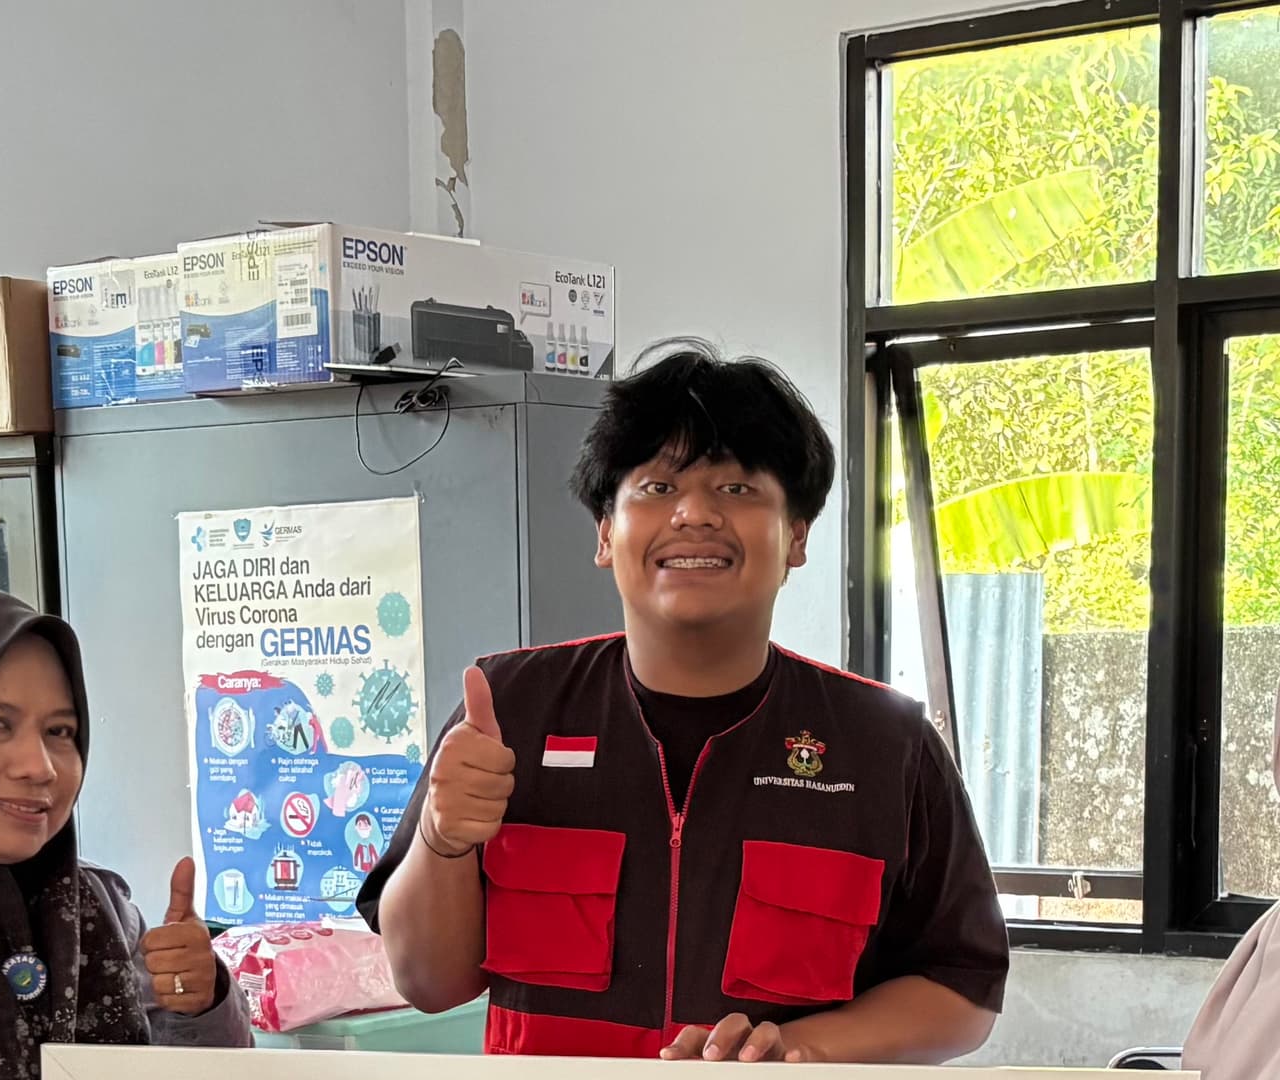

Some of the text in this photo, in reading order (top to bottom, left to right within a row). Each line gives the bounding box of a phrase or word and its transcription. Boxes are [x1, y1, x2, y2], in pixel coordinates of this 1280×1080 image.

[342, 236, 404, 266] EPSON
[167, 266, 179, 276] L12
[183, 252, 224, 272] EPSON
[343, 261, 404, 275] EXCEED YOUR VISION
[53, 277, 93, 295] EPSON
[555, 271, 606, 289] EcoTank L121
[275, 526, 302, 535] GERMAS
[193, 556, 310, 580] JAGA DIRI dan
[195, 576, 371, 603] KELUARGA Anda dari
[195, 605, 298, 626] Virus Corona
[196, 624, 371, 657] dengan GERMAS
[330, 656, 350, 666] Hidup
[218, 675, 261, 689] Caranya:
[753, 776, 855, 792] UNIVERSITAS HASANUDDIN
